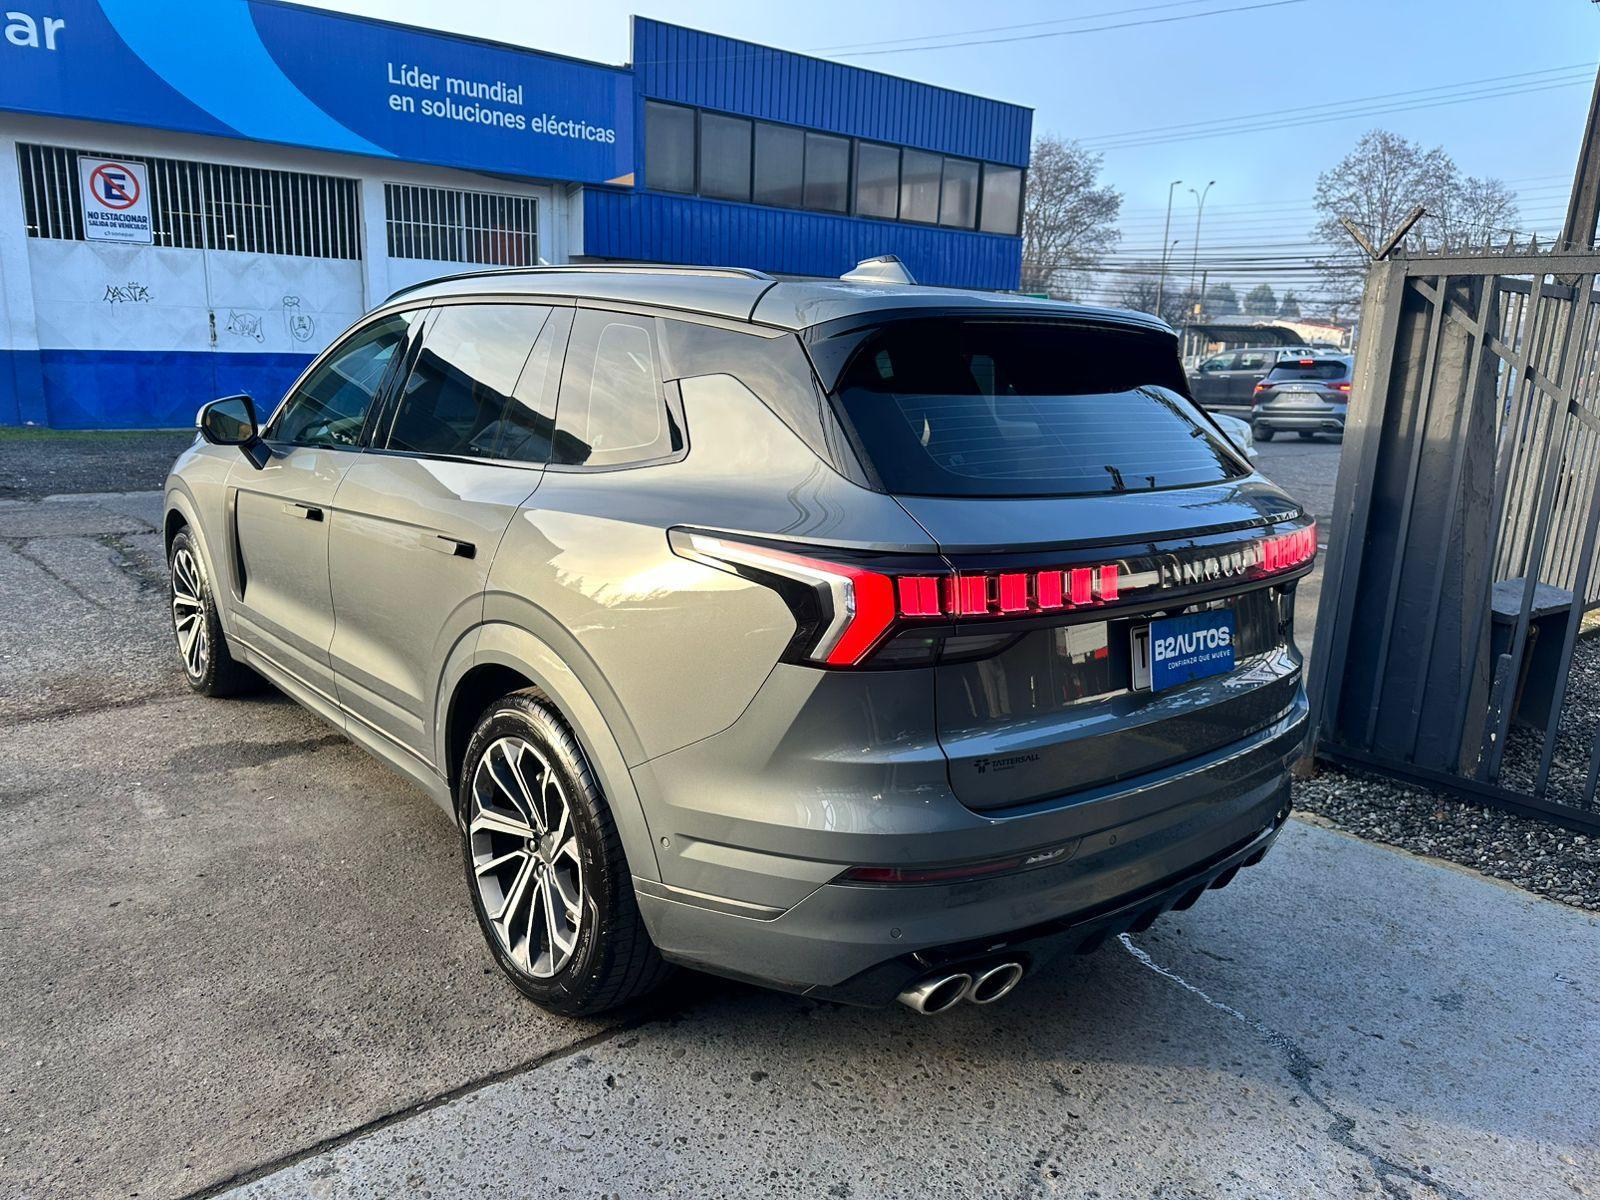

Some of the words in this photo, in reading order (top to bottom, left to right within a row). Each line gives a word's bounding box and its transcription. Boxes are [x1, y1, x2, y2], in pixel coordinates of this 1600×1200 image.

[387, 62, 440, 91] Líder
[446, 76, 523, 105] mundial
[388, 94, 415, 113] en
[421, 98, 526, 130] soluciones
[531, 113, 615, 144] eléctricas
[87, 211, 99, 220] NO
[100, 211, 148, 224] ESTACIONAR
[88, 220, 109, 228] SALIDA
[1154, 626, 1231, 661] B2AUTOS
[1167, 656, 1198, 670] CONFIANZA
[1198, 653, 1211, 663] QUE
[1211, 649, 1231, 660] MUEVE
[992, 753, 1041, 768] TATTERSALL
